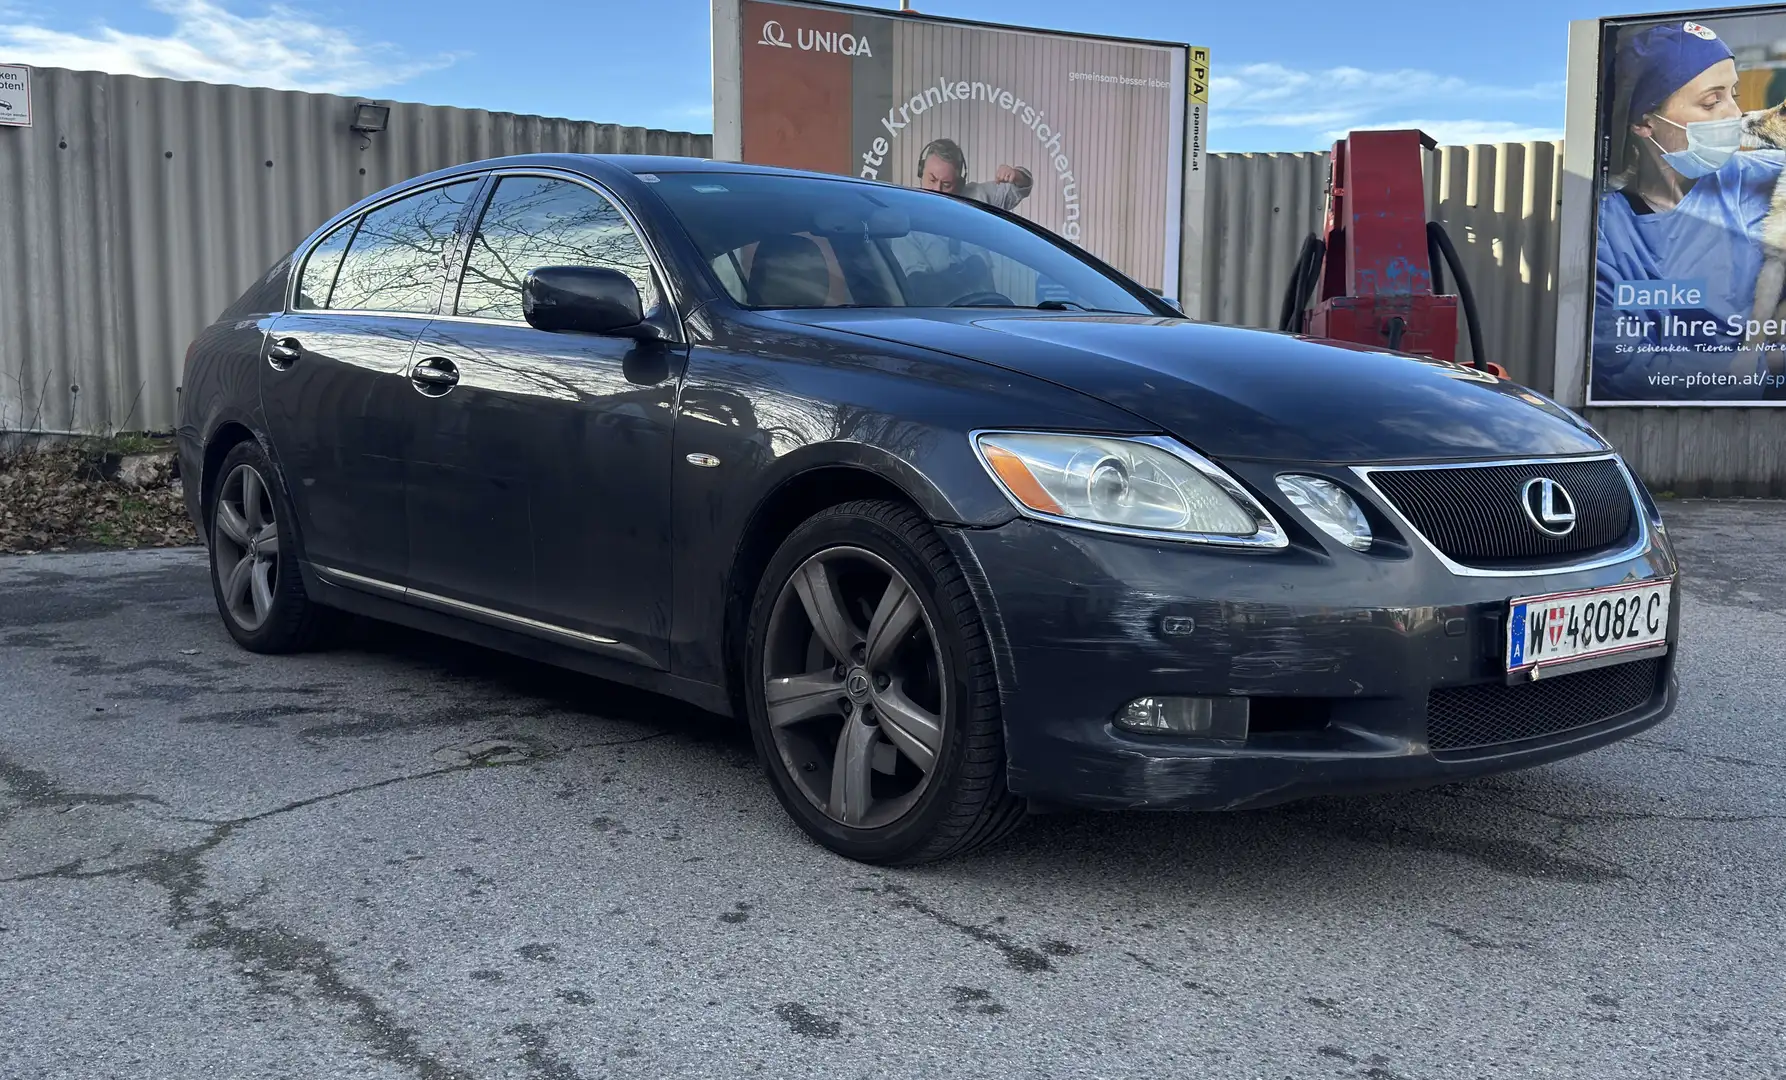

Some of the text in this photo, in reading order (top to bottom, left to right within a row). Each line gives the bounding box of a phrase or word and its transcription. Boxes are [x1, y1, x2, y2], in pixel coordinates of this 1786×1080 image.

[798, 28, 872, 57] UNIQA
[1069, 72, 1118, 84] gemeinsam
[1120, 75, 1147, 86] besser
[881, 77, 1081, 241] Krankenversicherung
[1618, 284, 1701, 306] Danke
[1615, 316, 1655, 338] für
[1664, 315, 1717, 337] Ihre
[1615, 344, 1633, 354] Sie
[1637, 343, 1690, 354] schenken
[1694, 344, 1733, 353] Tieren
[1737, 342, 1751, 352] in
[1755, 342, 1777, 352] Not
[1648, 370, 1785, 388] vier-pfoten.at/sp
[1530, 592, 1661, 656] W 48082 C
[1513, 643, 1520, 658] A
